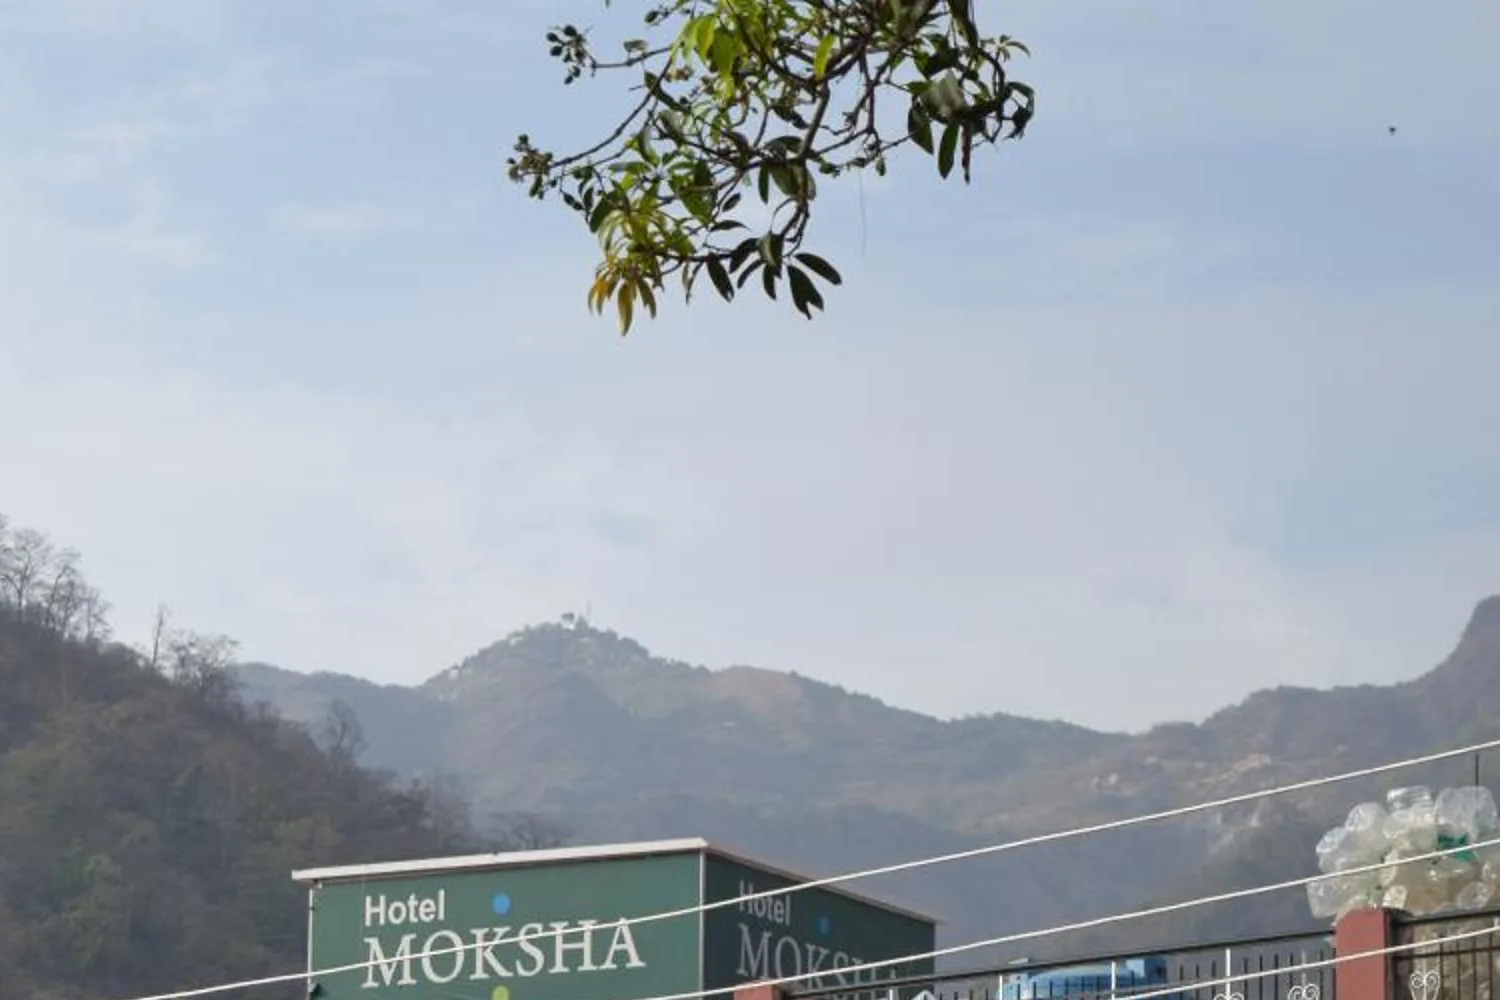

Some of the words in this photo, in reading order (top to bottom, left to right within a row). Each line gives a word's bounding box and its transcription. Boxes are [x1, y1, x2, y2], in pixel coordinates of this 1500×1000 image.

[363, 888, 446, 928] Hotel
[739, 879, 791, 926] Hotel
[360, 916, 648, 989] MOKSHA
